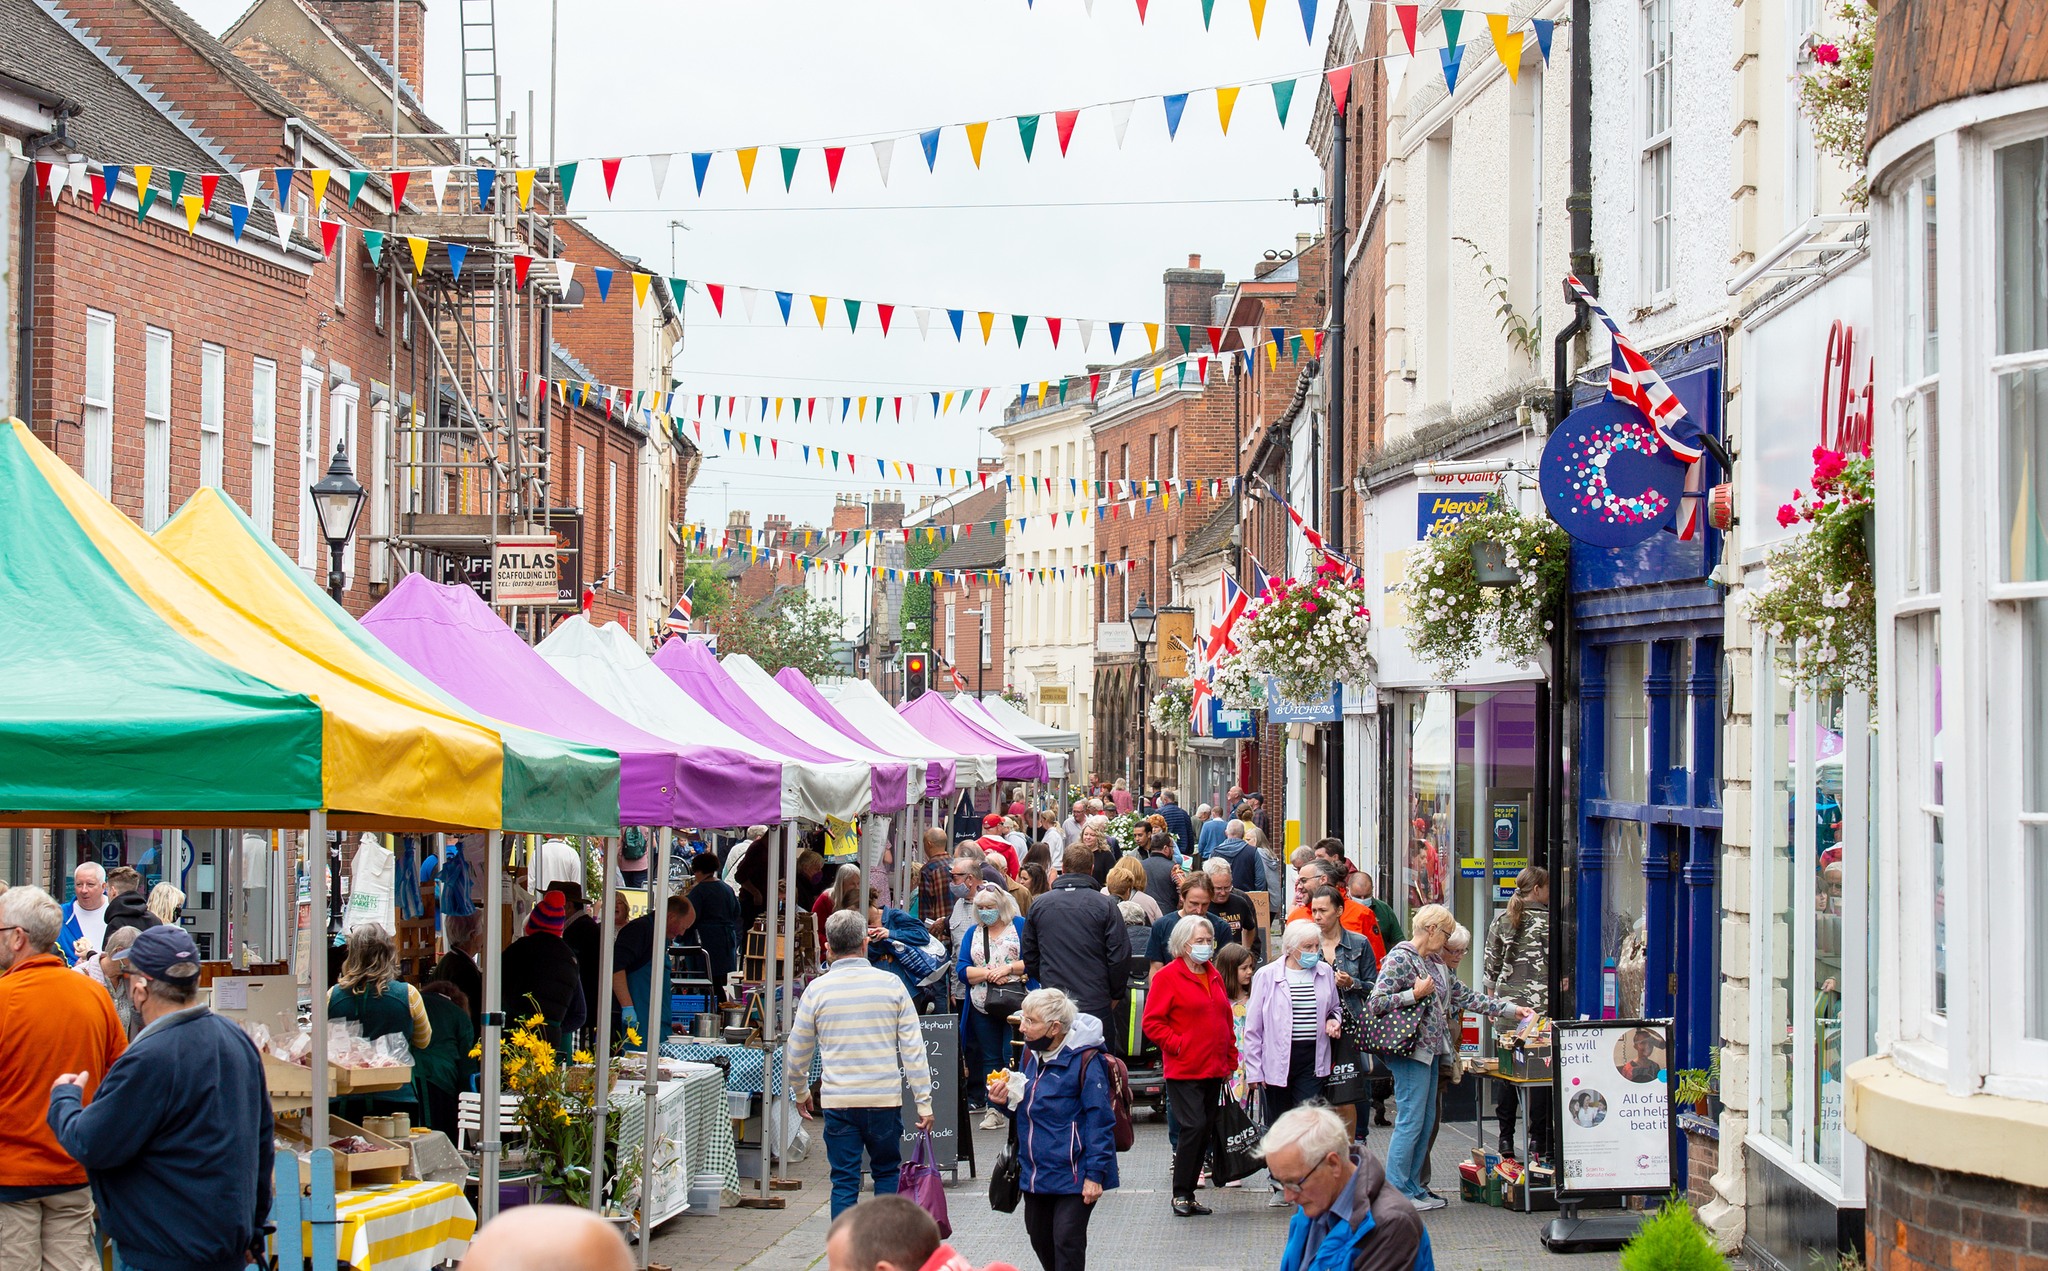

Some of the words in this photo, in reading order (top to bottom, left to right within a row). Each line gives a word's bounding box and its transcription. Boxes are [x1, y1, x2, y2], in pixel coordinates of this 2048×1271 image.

[1457, 472, 1502, 484] Quality
[1432, 498, 1488, 514] Heron
[498, 554, 556, 569] ATLAS
[498, 572, 542, 580] SCAFFOLDING
[1274, 704, 1334, 716] BUTCHERS
[920, 1021, 953, 1031] elephant
[1568, 1028, 1578, 1037] in
[1582, 1029, 1588, 1037] 2
[1576, 1040, 1596, 1050] will
[1560, 1055, 1579, 1066] get
[1582, 1054, 1592, 1063] it.
[1623, 1094, 1638, 1104] All
[1641, 1094, 1653, 1103] of
[1619, 1109, 1640, 1117] can
[1644, 1107, 1668, 1119] help
[1631, 1120, 1657, 1130] beat
